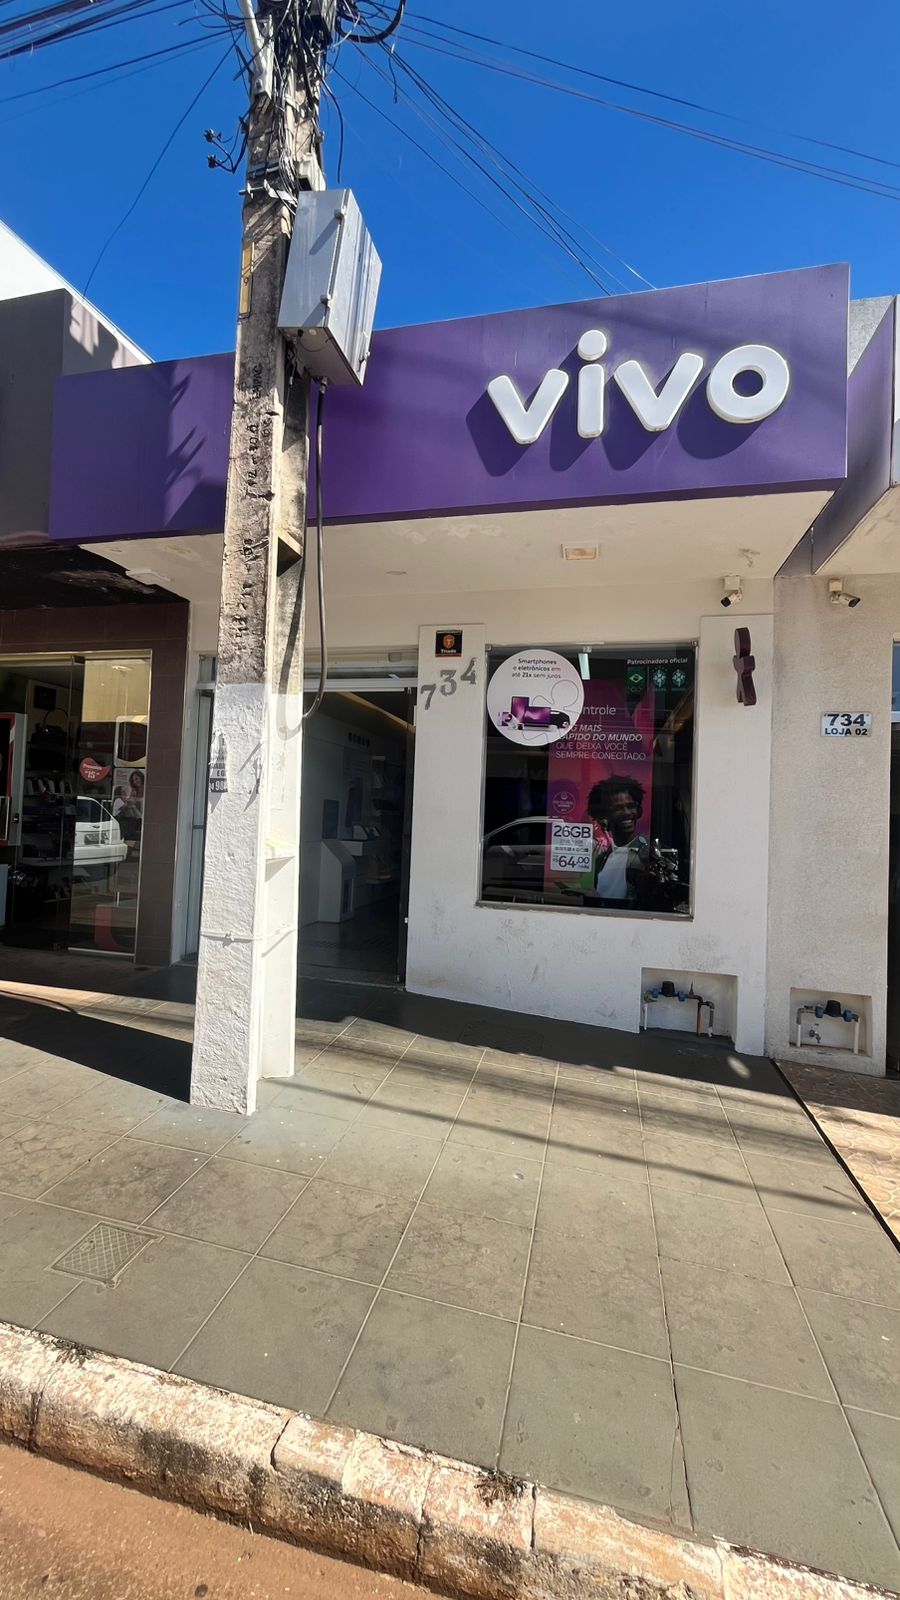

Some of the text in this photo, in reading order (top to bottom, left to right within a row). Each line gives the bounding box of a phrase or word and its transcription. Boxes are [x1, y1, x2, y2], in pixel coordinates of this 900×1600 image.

[487, 329, 790, 445] vivo
[518, 658, 557, 666] Smartphones
[420, 656, 477, 711] 734
[827, 713, 866, 726] 734
[580, 724, 602, 732] MAIS
[825, 728, 868, 736] LOJA 02
[607, 733, 643, 742] MUNDO
[555, 741, 628, 751] QUE DEIXA VOCÊ
[555, 751, 646, 760] SEMPRE CONECTADO
[553, 825, 591, 838] 26GB
